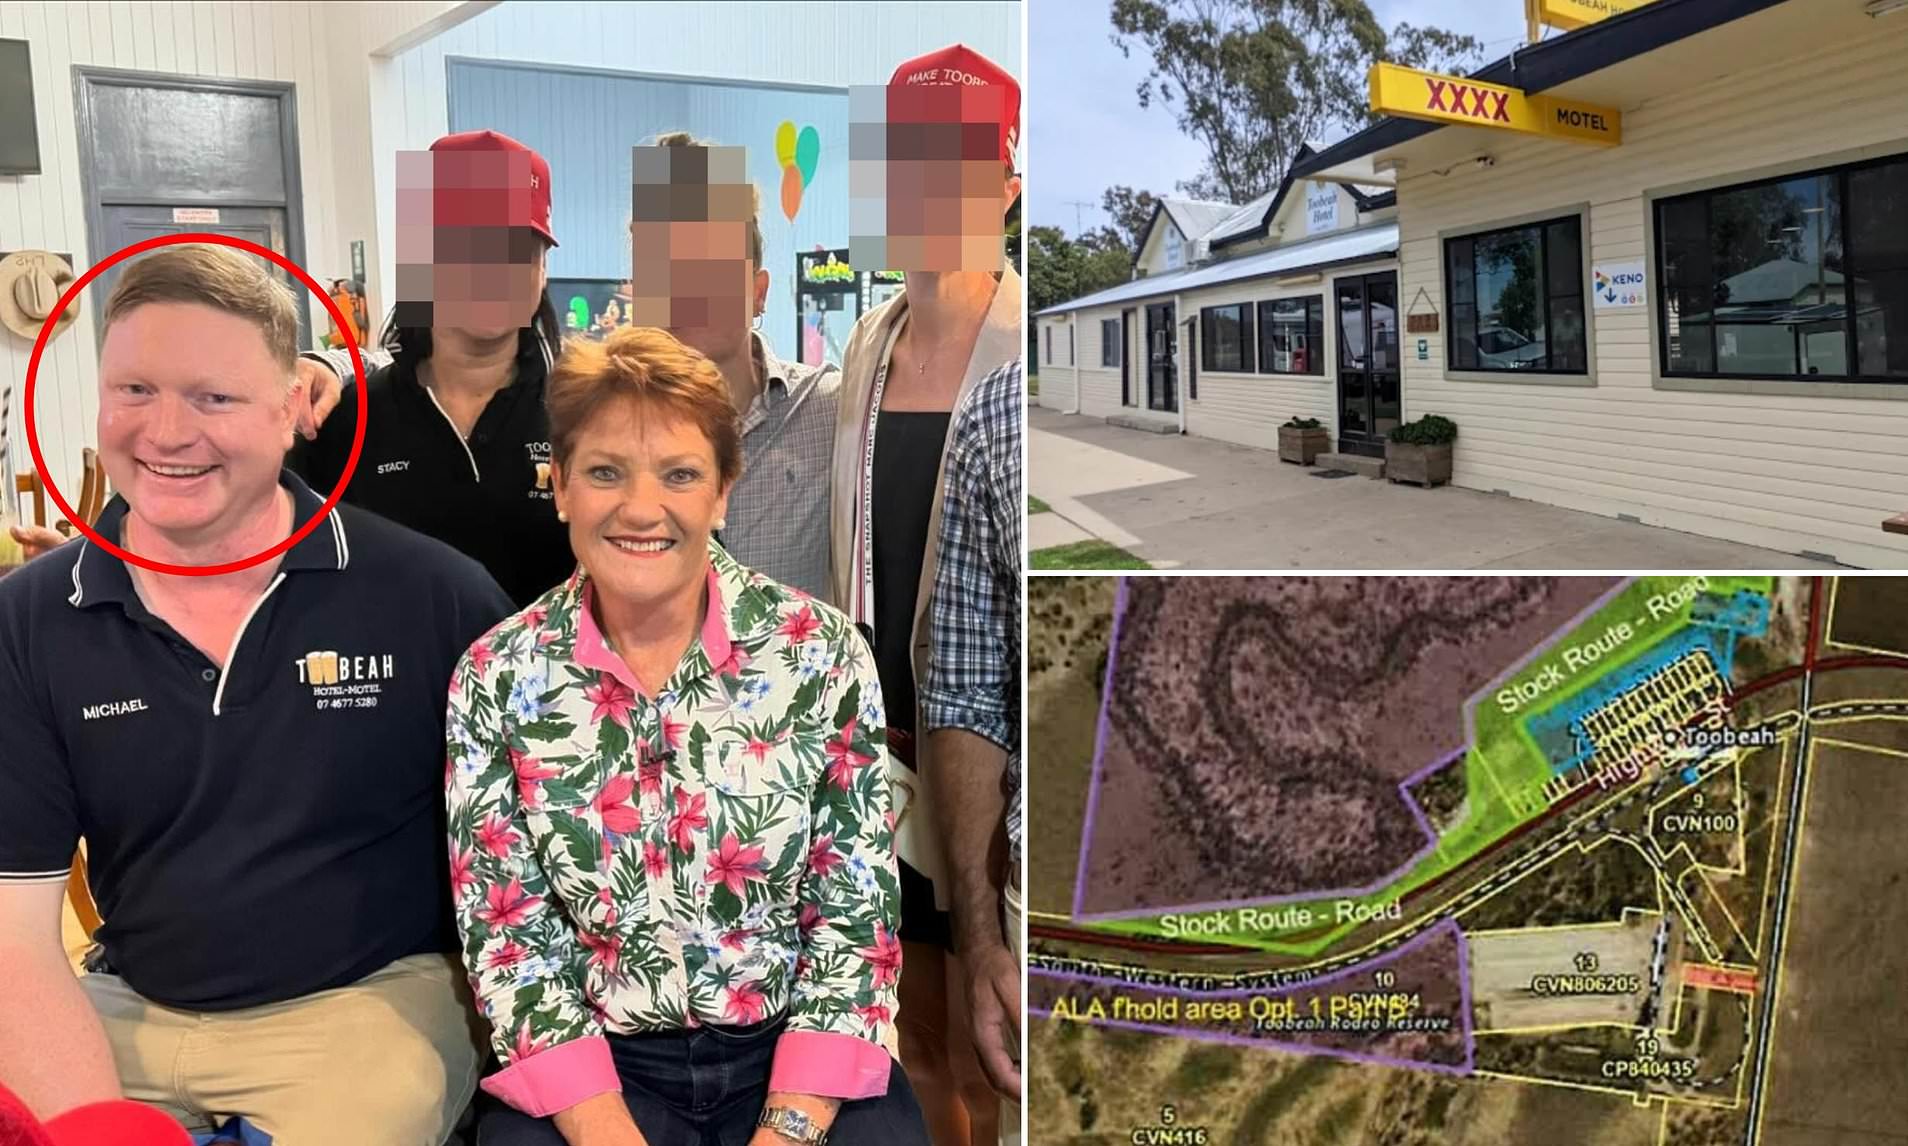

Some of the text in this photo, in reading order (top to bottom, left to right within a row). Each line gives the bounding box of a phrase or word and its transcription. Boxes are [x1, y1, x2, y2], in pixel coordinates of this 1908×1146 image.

[906, 69, 939, 85] MAKE
[1425, 78, 1608, 131] XXXX MOTEL
[1313, 206, 1333, 224] Hotel
[1612, 273, 1644, 286] KENO
[866, 429, 874, 467] MARC
[377, 461, 410, 474] STACY
[1497, 665, 1565, 713] Stock
[1561, 621, 1634, 673] Route
[1645, 577, 1710, 620] Road
[82, 698, 149, 720] MICHAEL
[316, 697, 377, 710] 07 4677 5280
[1685, 728, 1774, 743] Toobeah
[1693, 794, 1703, 809] 9
[1663, 816, 1735, 831] CVN100
[1160, 913, 1232, 939] Stock
[1239, 908, 1313, 932] Route
[1336, 897, 1402, 923] Road
[1575, 954, 1597, 971] 13
[1375, 971, 1394, 987] 10
[1533, 977, 1639, 992] CVN806205
[1052, 997, 1106, 1021] ALA
[1185, 1001, 1242, 1020] area
[1250, 996, 1299, 1025] Opt.
[1310, 997, 1321, 1019] 1
[1329, 1017, 1380, 1031] Rodeo
[1386, 1017, 1450, 1031] Reserve
[1638, 1040, 1658, 1055] 19
[1602, 1060, 1693, 1077] CP840435
[1162, 1106, 1176, 1123] 5
[1131, 1129, 1208, 1146] CVN416
